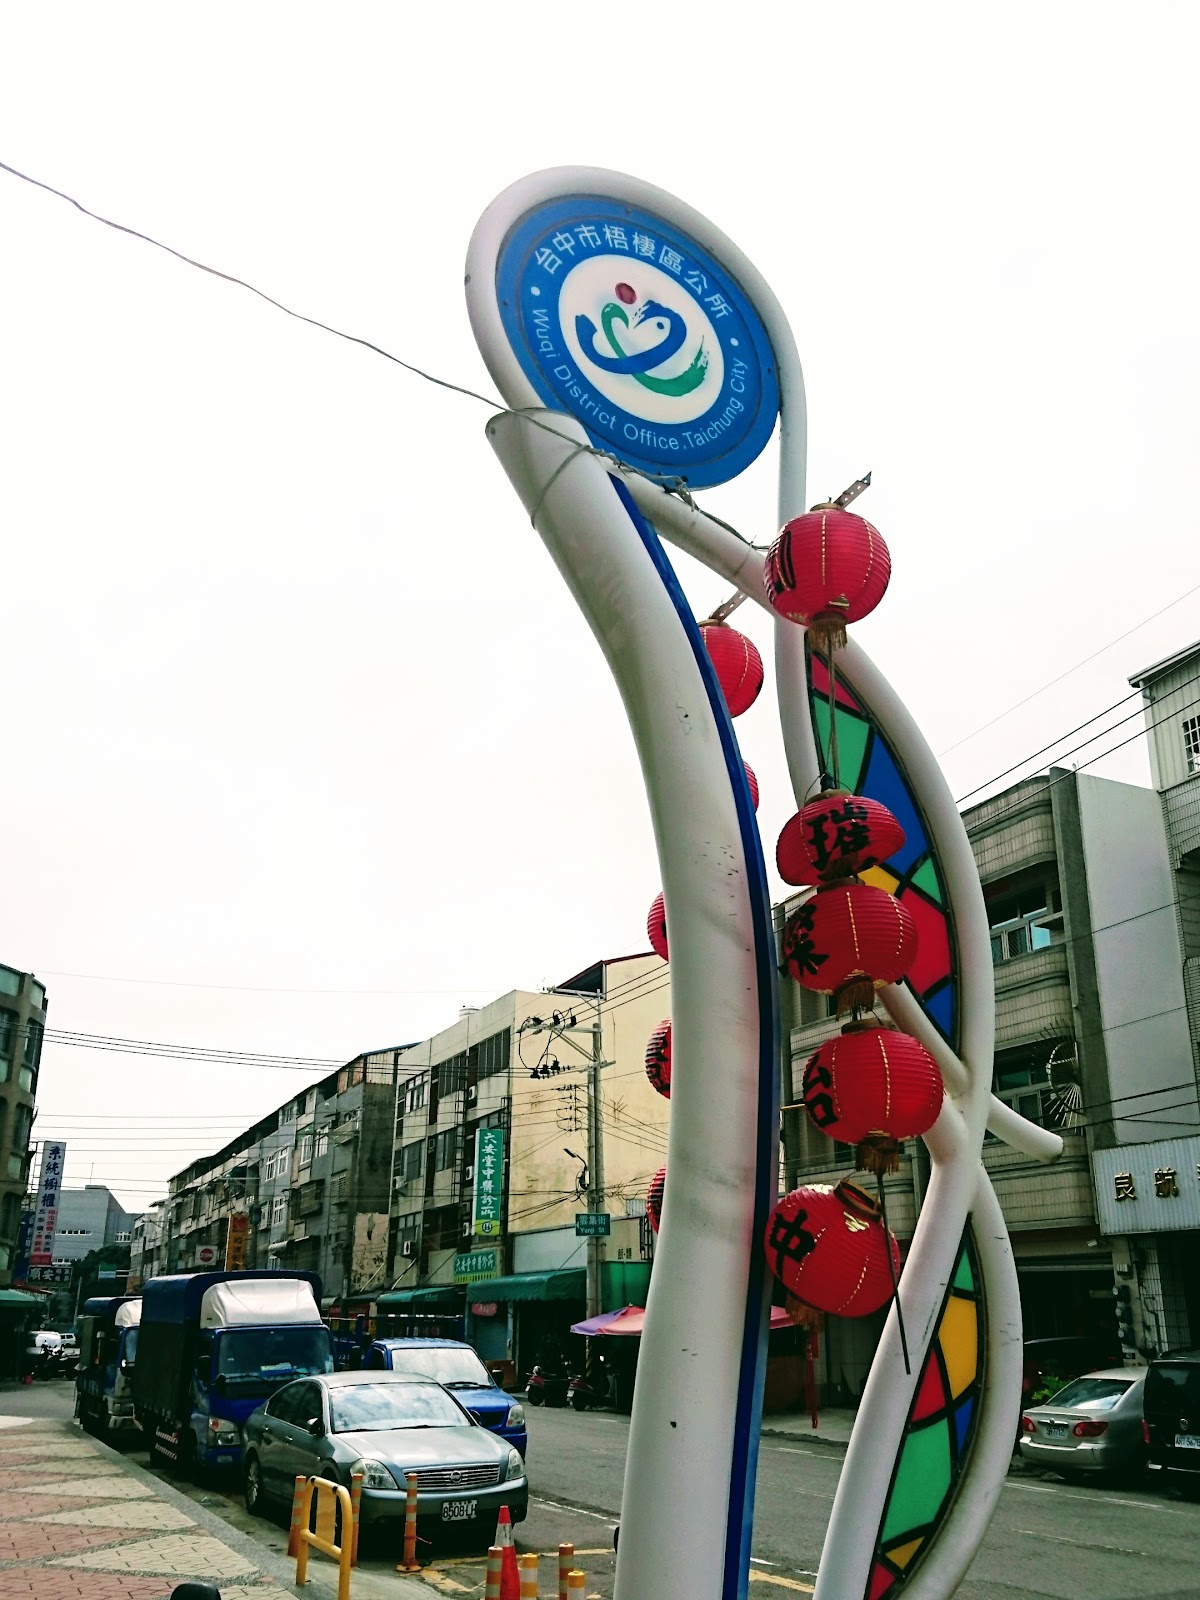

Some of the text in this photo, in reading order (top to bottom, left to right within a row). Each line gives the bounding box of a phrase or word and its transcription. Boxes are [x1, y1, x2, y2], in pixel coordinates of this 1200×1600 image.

[535, 223, 732, 320] 台中市梧棲區公所
[531, 308, 561, 361] Wuqi
[553, 364, 617, 430] District
[729, 357, 749, 394] City
[480, 1132, 498, 1219] 六安堂中醫診所
[579, 1215, 606, 1226] 雲集街
[769, 1208, 816, 1279] 中
[443, 1502, 477, 1518] 8508-LH
